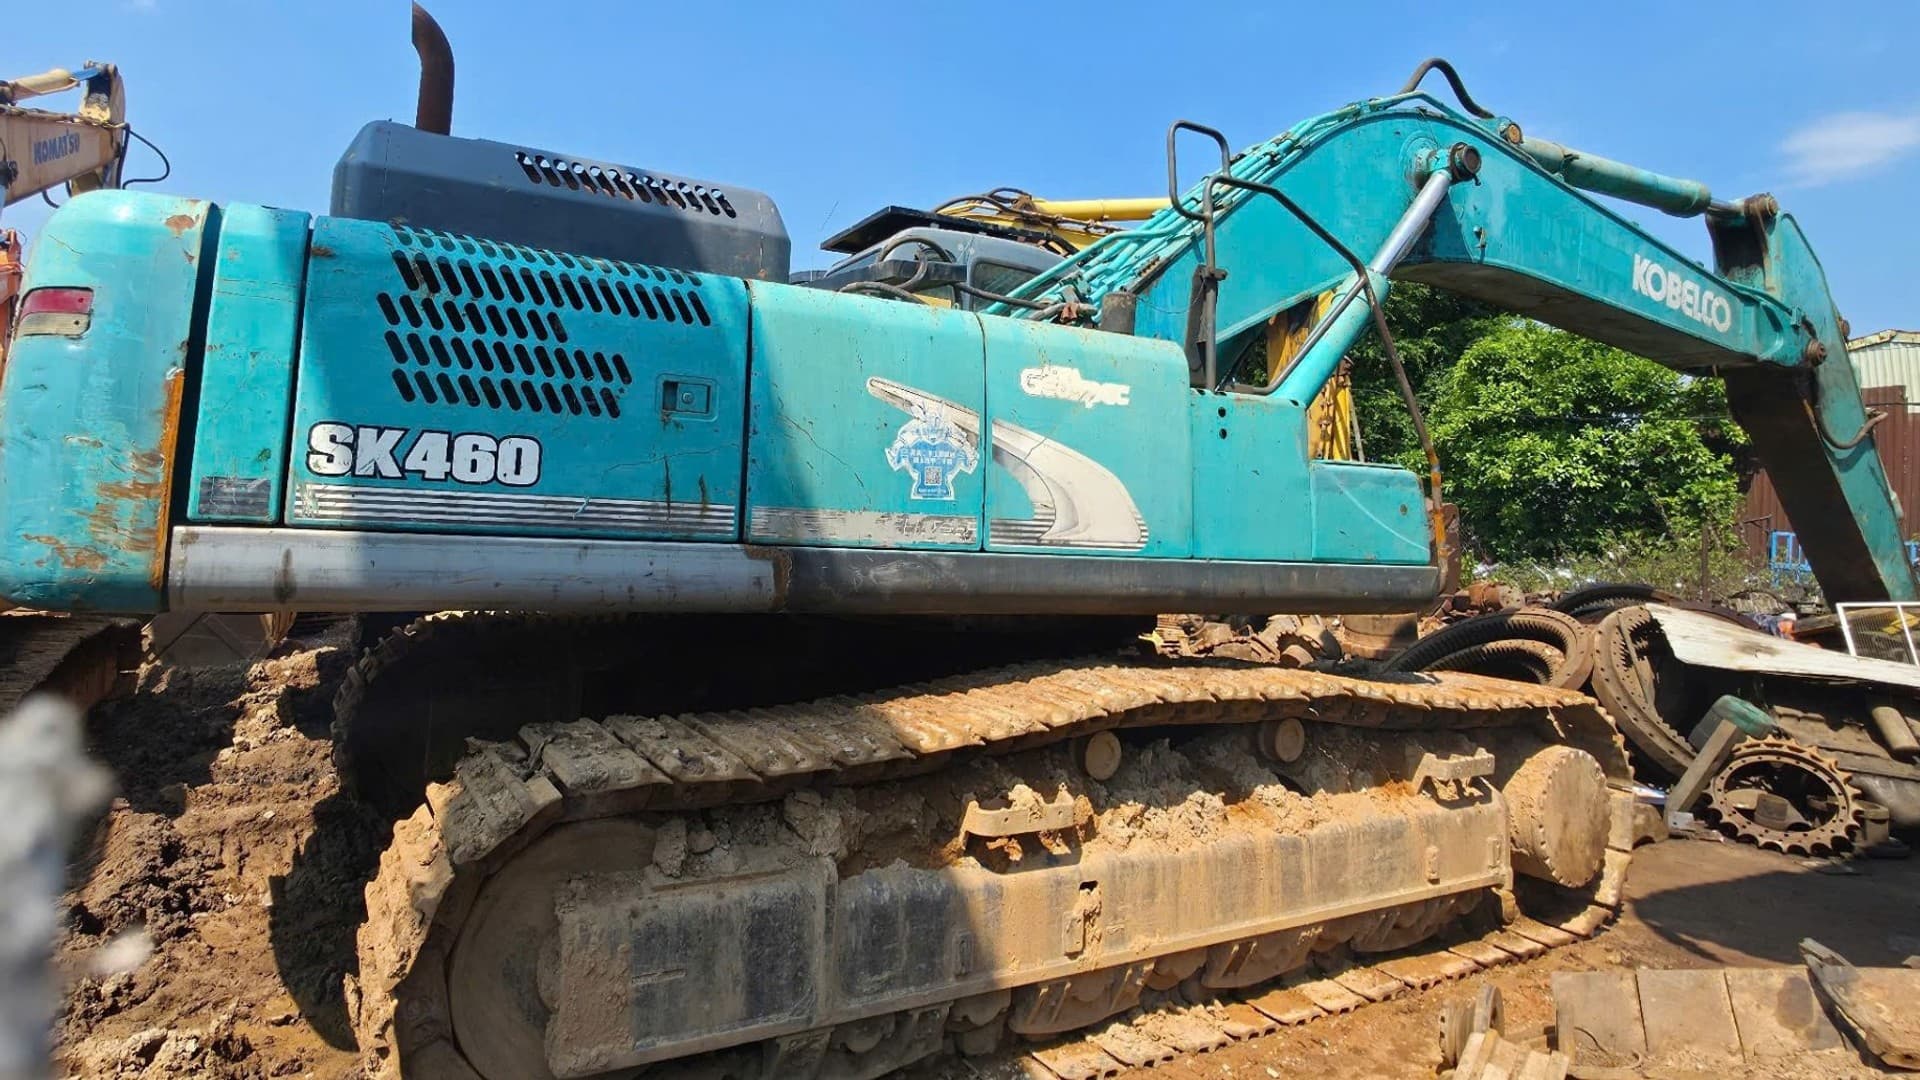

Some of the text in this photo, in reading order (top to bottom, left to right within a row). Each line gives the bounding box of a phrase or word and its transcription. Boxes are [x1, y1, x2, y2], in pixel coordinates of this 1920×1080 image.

[33, 130, 81, 165] KOMATSU
[1632, 254, 1732, 333] KOBELCO
[307, 421, 542, 487] SK460
